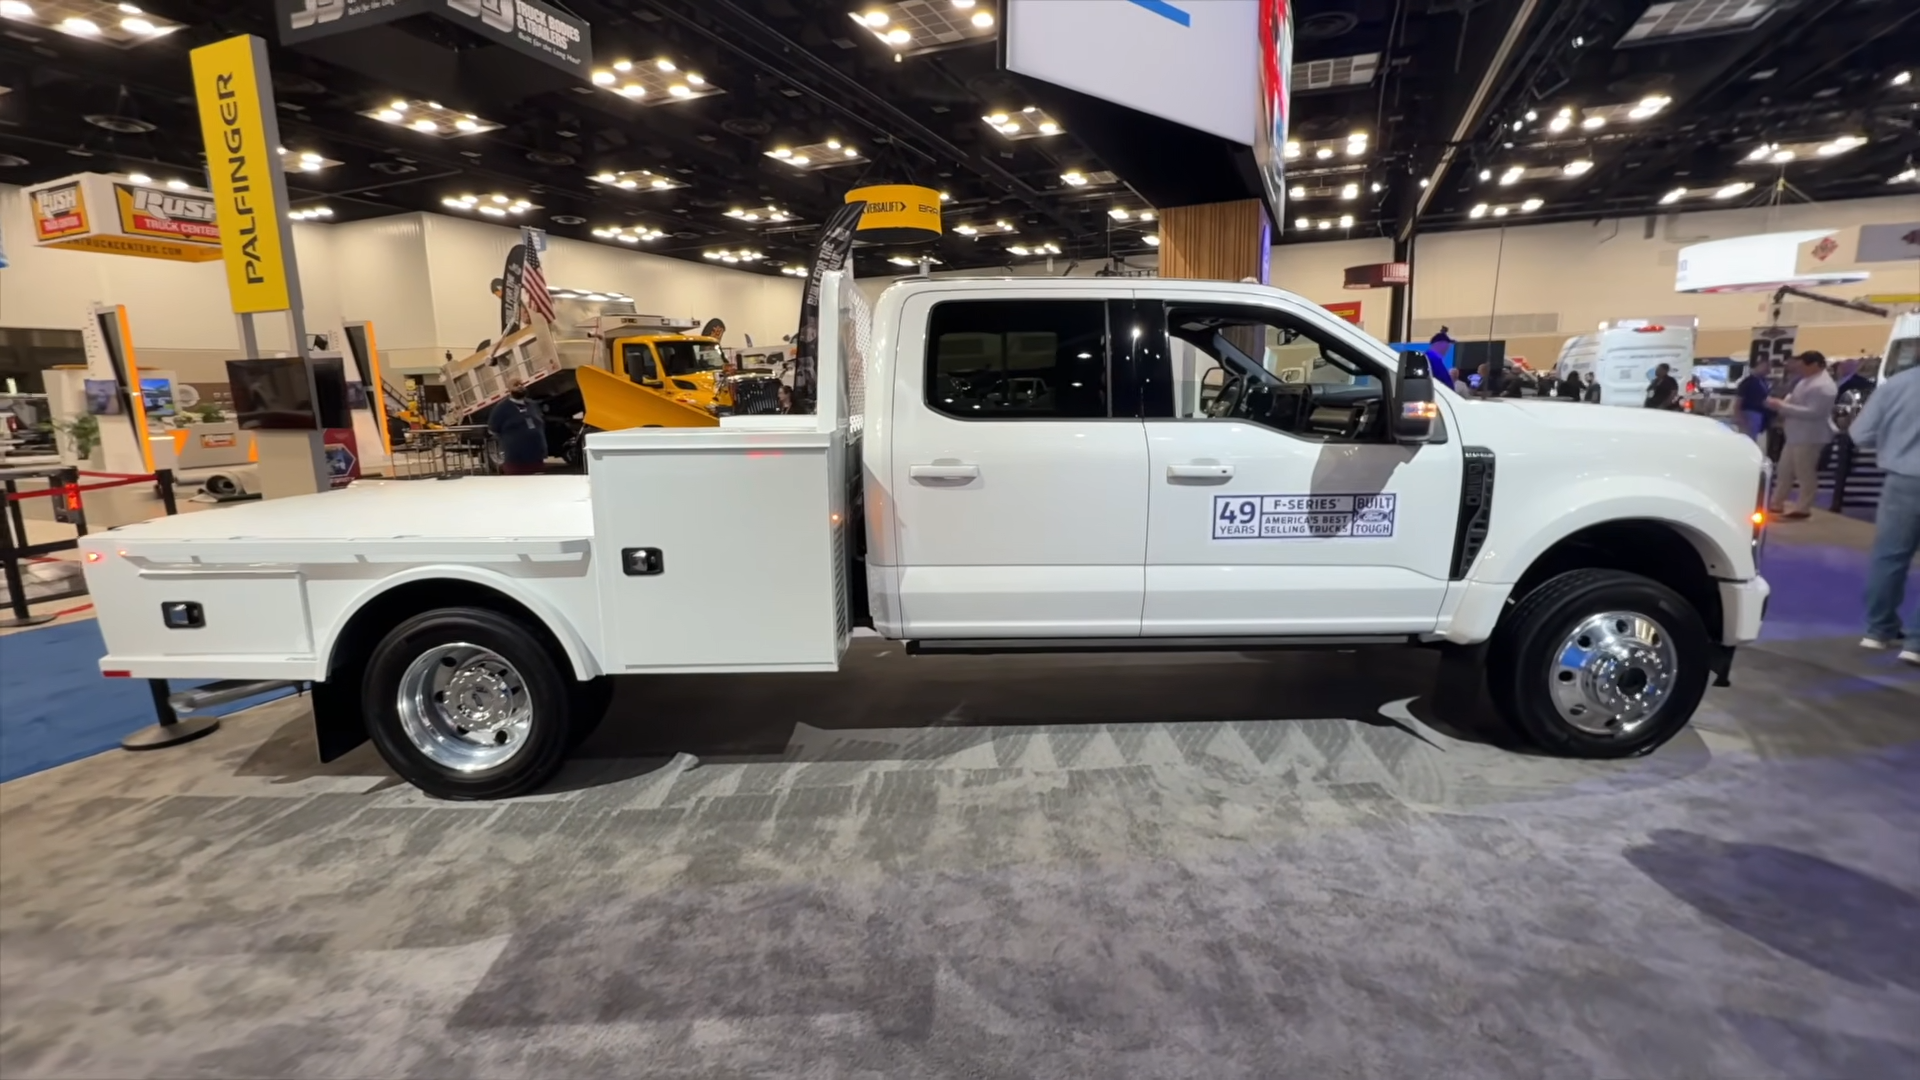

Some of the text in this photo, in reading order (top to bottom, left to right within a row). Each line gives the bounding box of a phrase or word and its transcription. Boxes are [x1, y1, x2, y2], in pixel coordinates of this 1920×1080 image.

[516, 0, 547, 27] TRUCK
[548, 15, 580, 42] BODIES
[517, 15, 527, 31] &
[526, 18, 568, 50] TRAILERS
[216, 72, 264, 284] PALFINGER
[867, 201, 899, 214] VERSALIFT
[144, 217, 219, 237] TRUCK CENTER
[819, 240, 835, 261] THE
[1274, 499, 1337, 510] F-SERIES
[1357, 497, 1392, 509] BUILT
[1219, 501, 1256, 524] 49
[1265, 515, 1348, 525] AMERICA'S BEST
[1219, 526, 1256, 535] YEARS
[1264, 524, 1348, 534] SELLING TRUCKS
[1355, 524, 1390, 534] TOUGH
